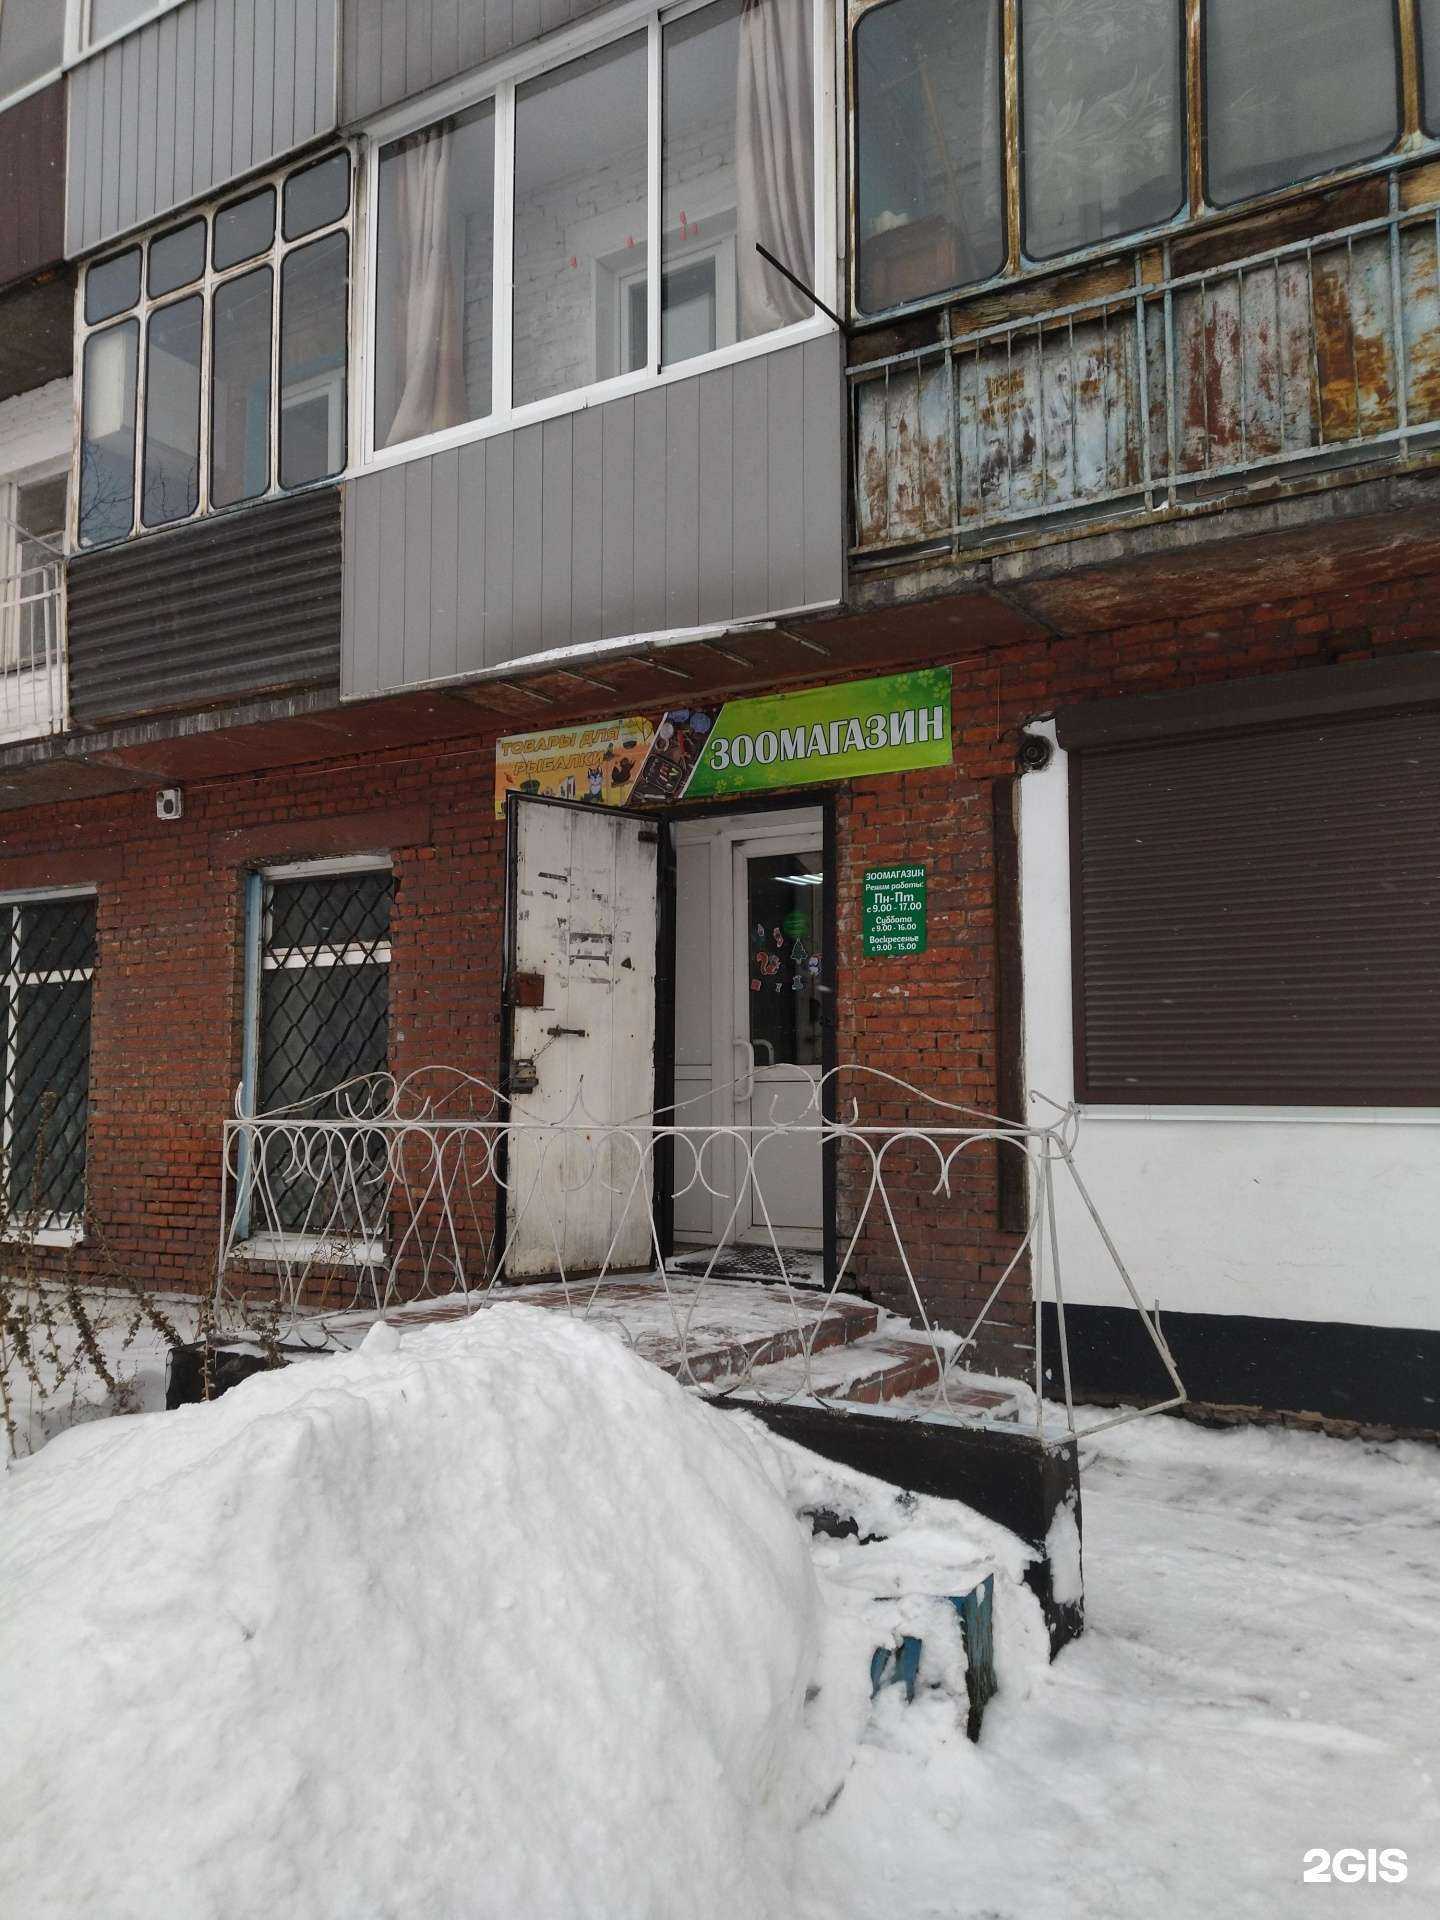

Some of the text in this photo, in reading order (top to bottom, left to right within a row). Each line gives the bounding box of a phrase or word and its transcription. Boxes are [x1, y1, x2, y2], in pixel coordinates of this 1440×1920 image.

[501, 726, 620, 757] ТОВАРЫ ДЛЯ
[709, 705, 945, 772] ЗООМАГАЗИН
[512, 750, 605, 777] РЫБАЛКИ
[866, 868, 924, 881] ЗООМАГАЗИН
[865, 883, 890, 891] Режим
[874, 891, 914, 904] Пн-Пт
[872, 903, 892, 913] 9.00
[899, 902, 922, 911] 17.00
[875, 915, 912, 924] Суббота
[876, 924, 892, 932] 9.00
[898, 923, 917, 931] 16.00
[869, 935, 919, 944] Воскресенье
[876, 943, 892, 952] 9.00
[897, 942, 917, 950] 15.00
